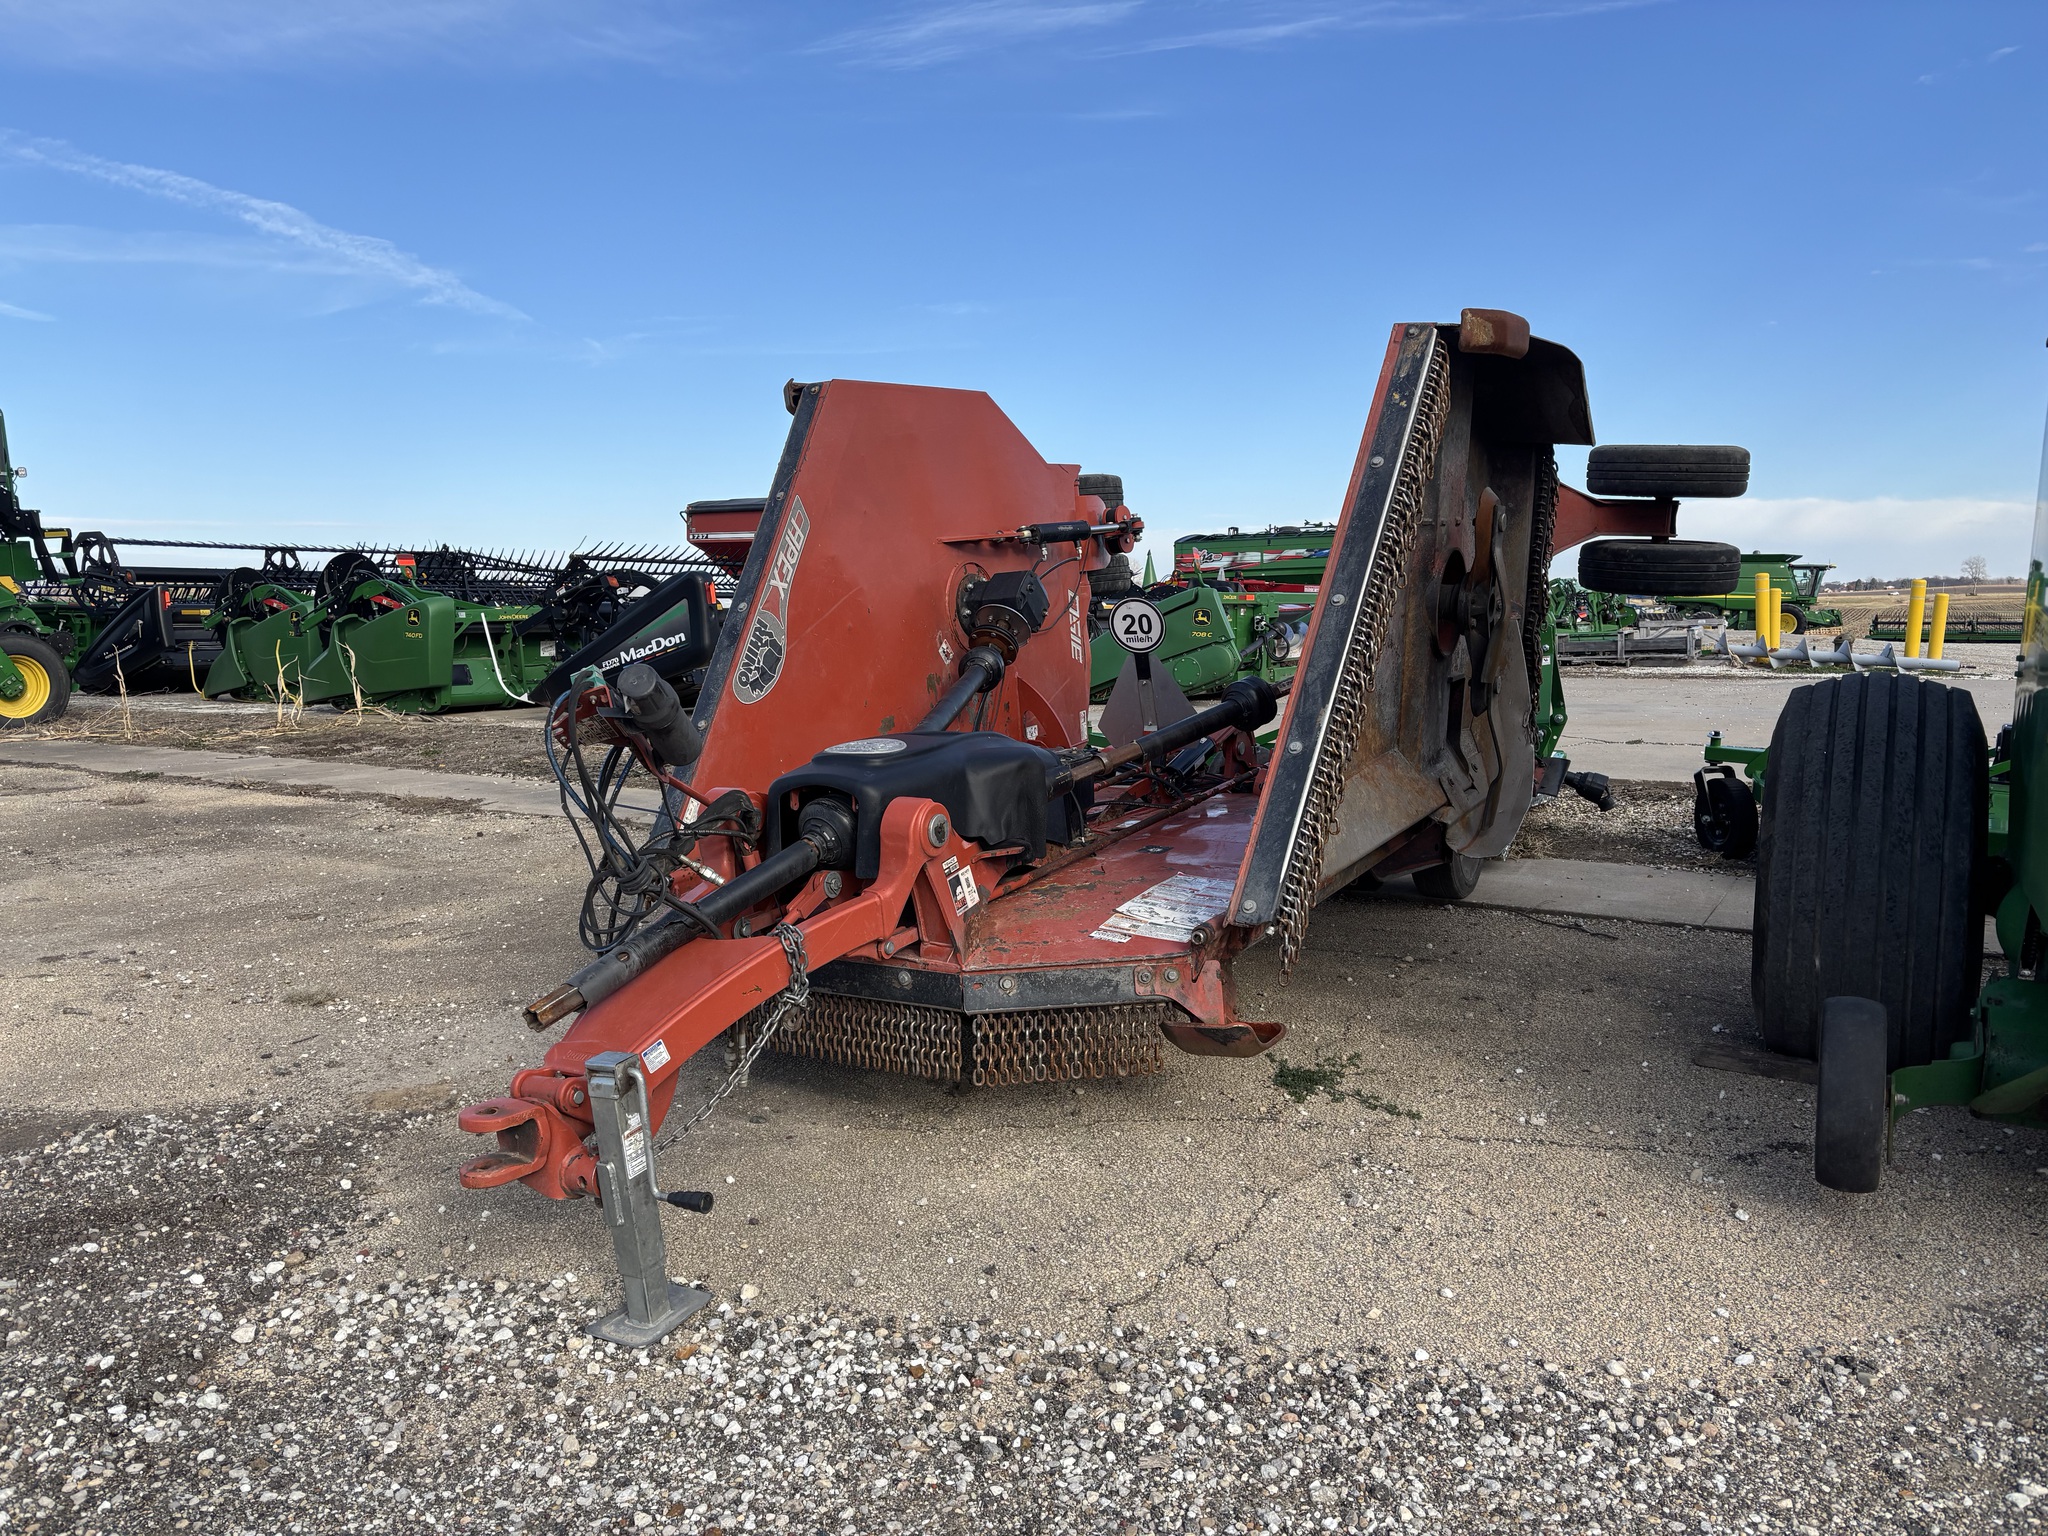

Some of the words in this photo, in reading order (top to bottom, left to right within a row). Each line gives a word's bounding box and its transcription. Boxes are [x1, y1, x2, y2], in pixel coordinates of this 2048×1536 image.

[769, 510, 805, 600] APEX
[1122, 613, 1152, 635] 20
[1125, 635, 1153, 643] mile/h
[620, 632, 686, 664] MacDon
[737, 616, 775, 689] RHINO
